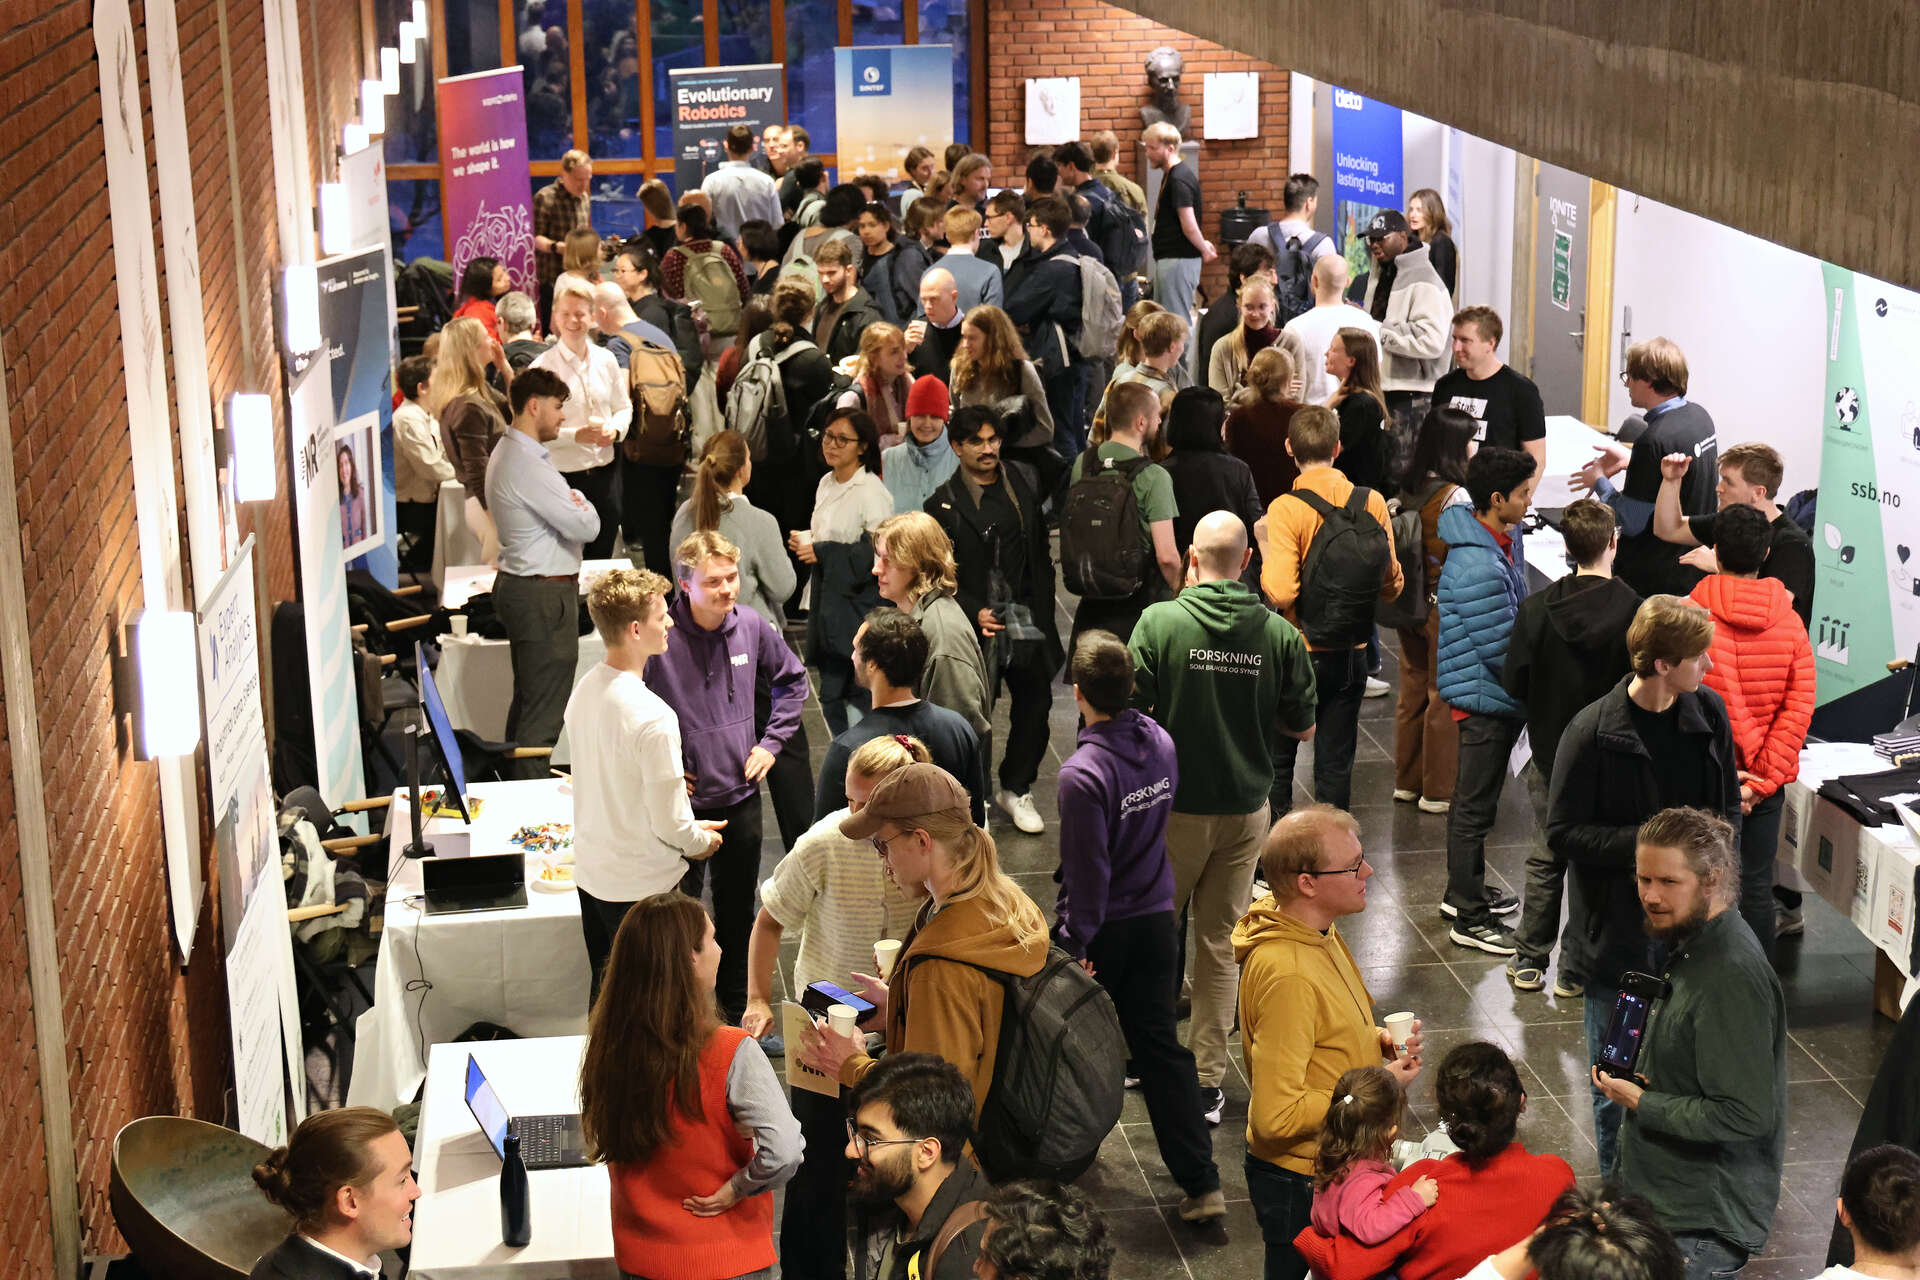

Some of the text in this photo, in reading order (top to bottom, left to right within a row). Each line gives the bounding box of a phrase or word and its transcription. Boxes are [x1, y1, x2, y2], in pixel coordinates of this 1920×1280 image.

[677, 86, 774, 104] Evolutionary
[678, 104, 747, 121] Robotics
[451, 138, 515, 160] The world is how
[452, 166, 465, 177] we
[466, 161, 490, 176] shape
[1336, 152, 1378, 177] Unlocking
[1336, 170, 1395, 196] lasting impact
[304, 432, 319, 489] NR
[1850, 481, 1901, 508] ssb.no
[1189, 648, 1262, 666] FORSKNING
[1189, 663, 1205, 671] SOM
[1228, 666, 1239, 674] OG
[1239, 667, 1260, 677] SYNES
